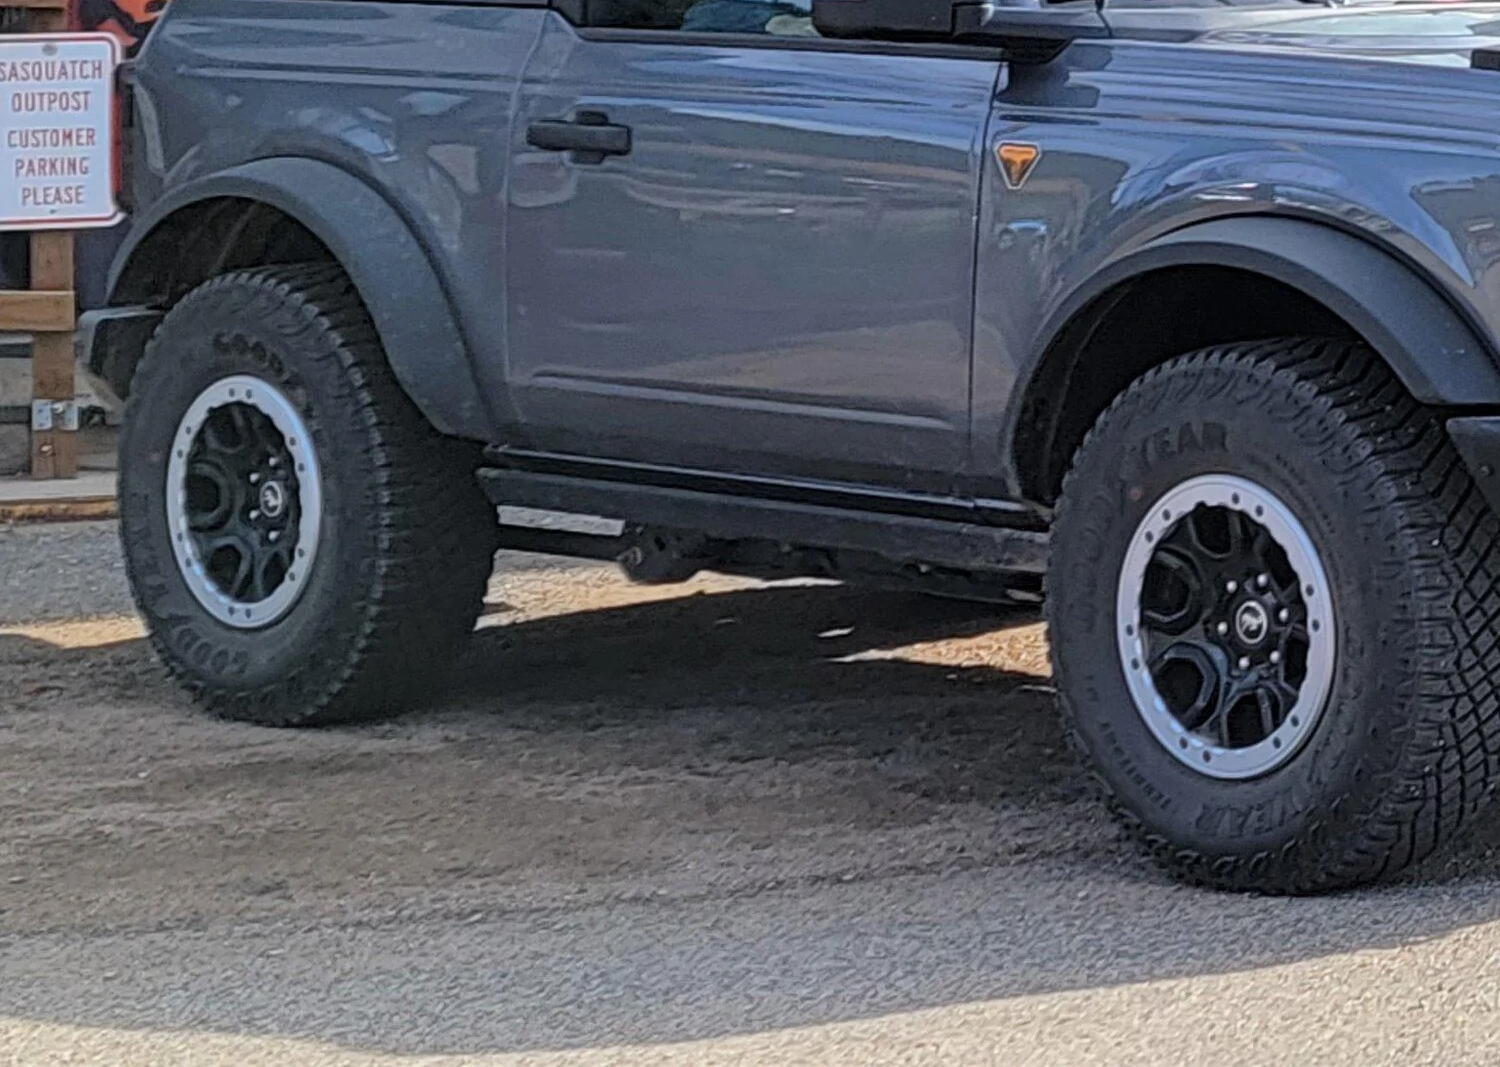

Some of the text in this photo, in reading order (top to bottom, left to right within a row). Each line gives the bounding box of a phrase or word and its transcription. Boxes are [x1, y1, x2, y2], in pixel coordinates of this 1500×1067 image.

[0, 59, 103, 82] SASQUATCH
[11, 90, 91, 112] OUTPOST
[7, 127, 96, 148] CUSTOMER
[15, 157, 90, 178] PARKING
[22, 185, 85, 207] PLEASE
